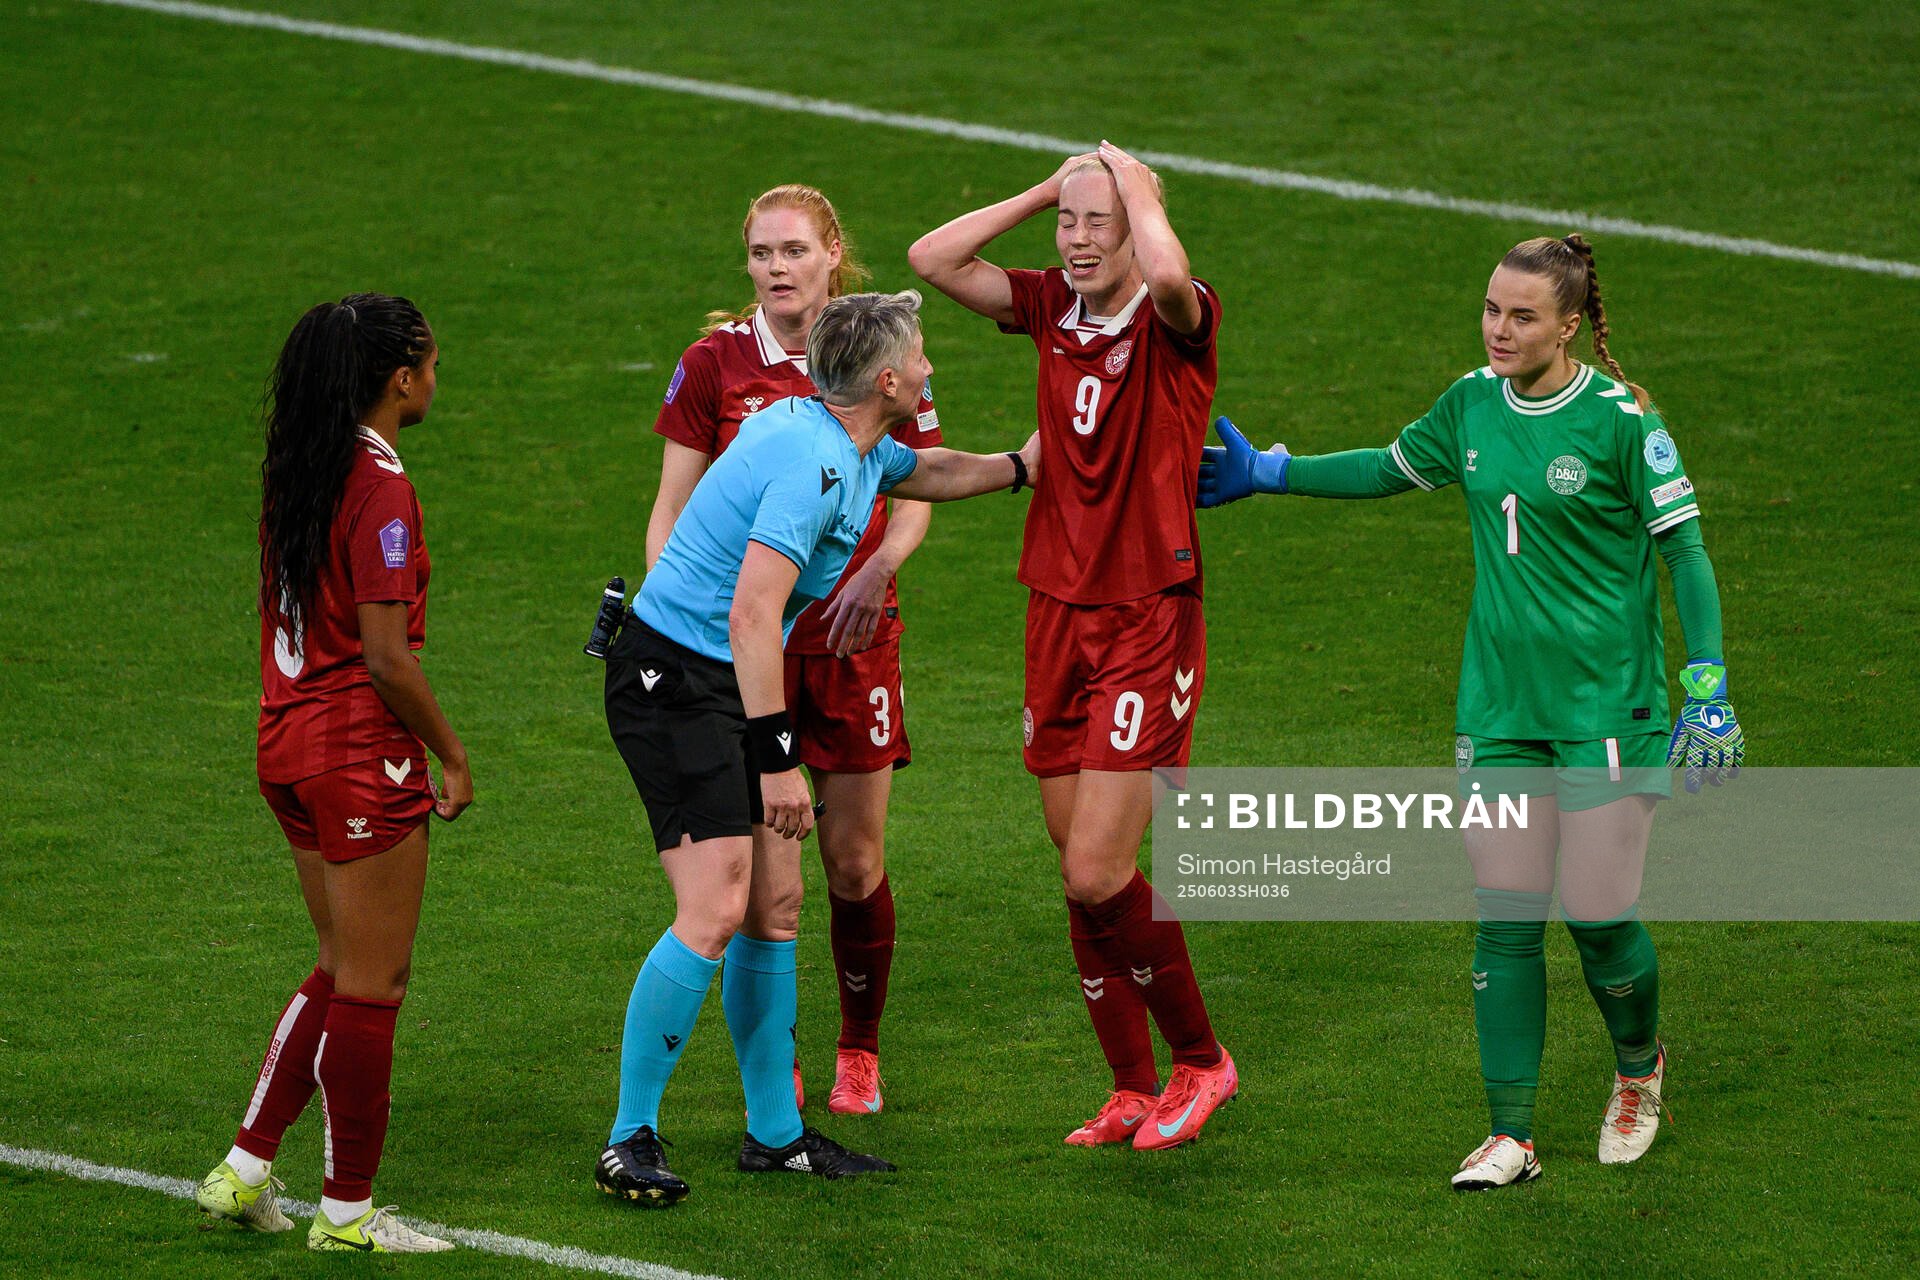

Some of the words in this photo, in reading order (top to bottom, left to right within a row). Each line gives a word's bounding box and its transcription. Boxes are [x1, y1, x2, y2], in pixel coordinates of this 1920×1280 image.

[1073, 376, 1102, 435] 9
[1555, 468, 1579, 482] DBU
[1501, 494, 1520, 555] 1
[868, 686, 890, 747] 3
[1110, 691, 1145, 751] 9
[784, 1160, 813, 1172] adidas
